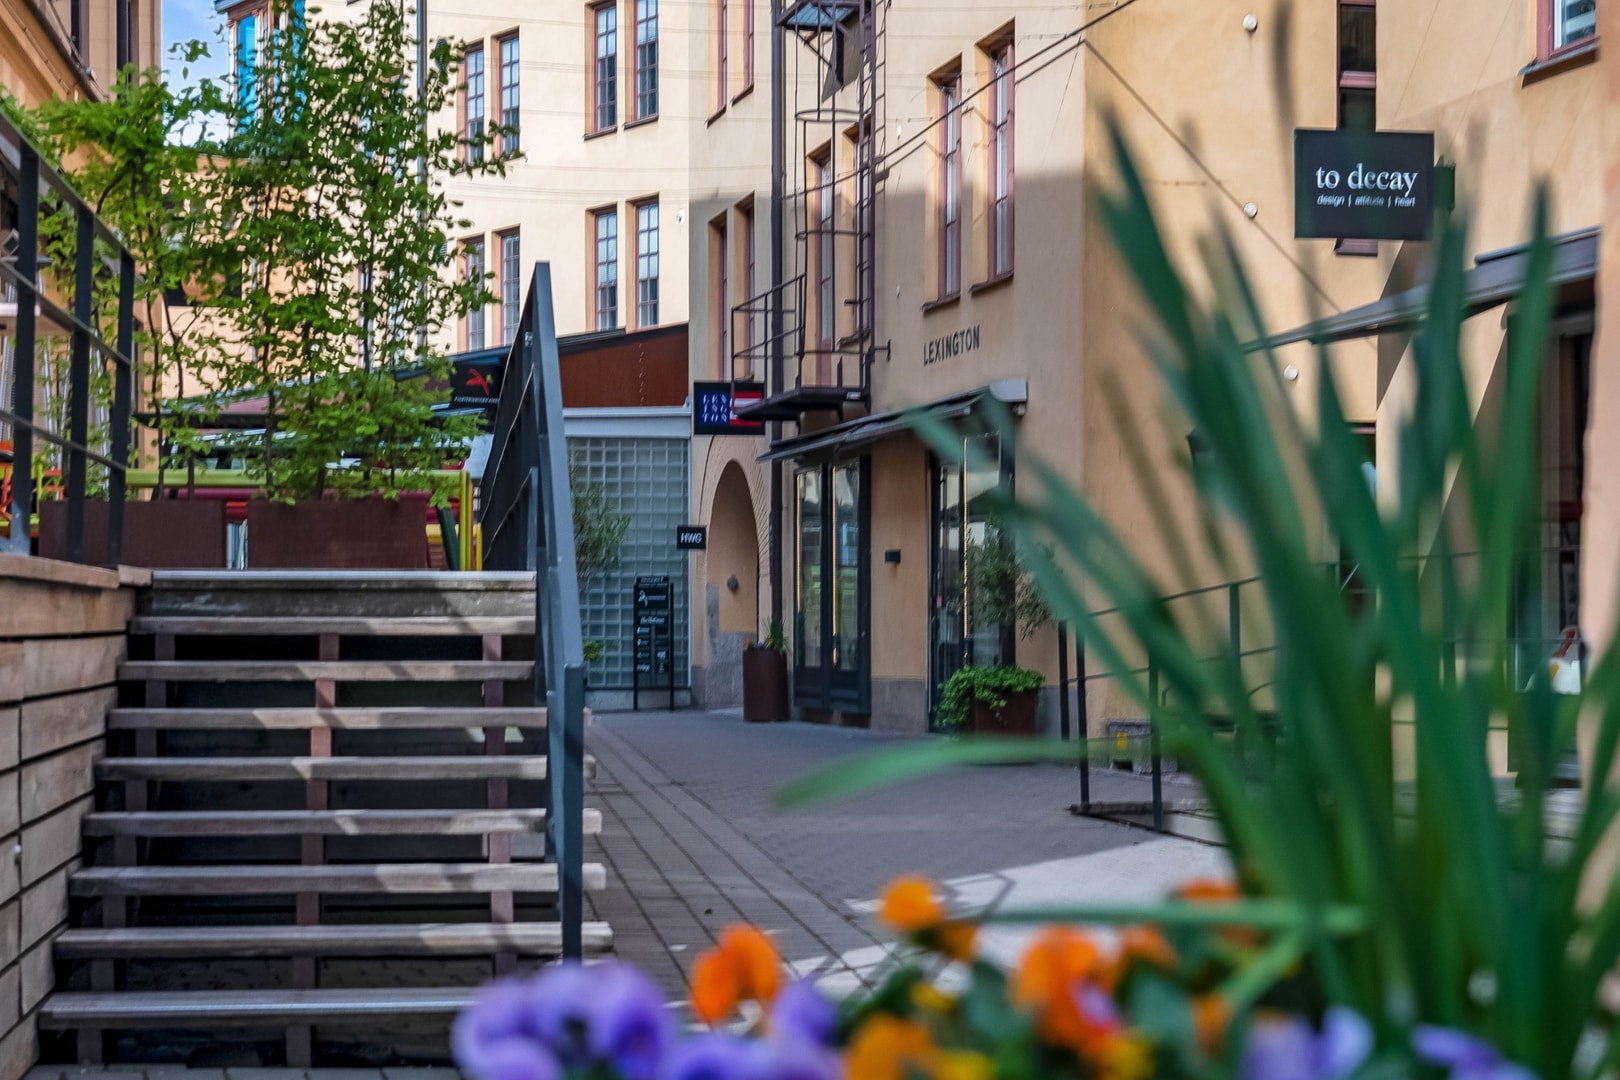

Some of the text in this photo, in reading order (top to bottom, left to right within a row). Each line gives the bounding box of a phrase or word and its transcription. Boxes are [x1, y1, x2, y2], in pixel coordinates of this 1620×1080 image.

[1315, 162, 1418, 198] to decay
[1317, 194, 1345, 207] design
[923, 324, 980, 367] LEXINGTON
